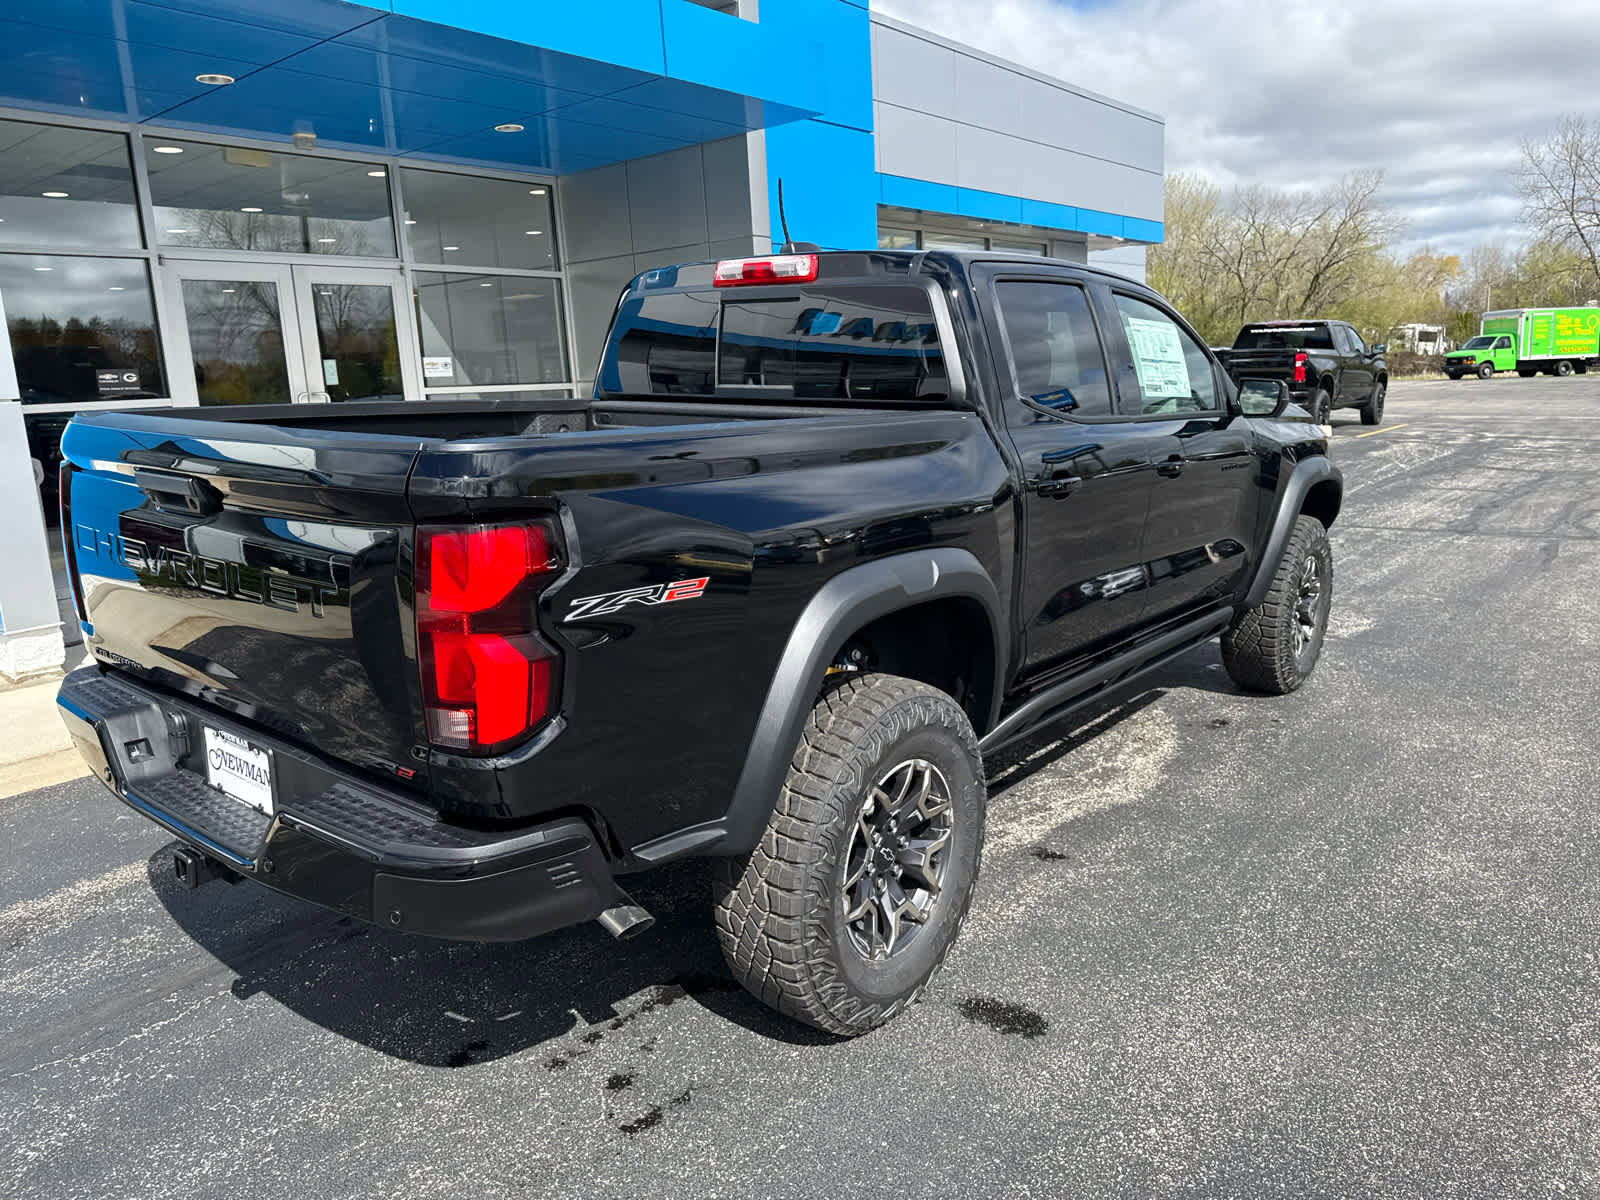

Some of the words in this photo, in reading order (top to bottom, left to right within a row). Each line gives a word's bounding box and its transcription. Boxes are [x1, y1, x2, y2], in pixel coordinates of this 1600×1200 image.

[75, 523, 340, 619] CHEVROLET
[563, 576, 710, 622] ZR2
[209, 748, 271, 787] NEWMAN
